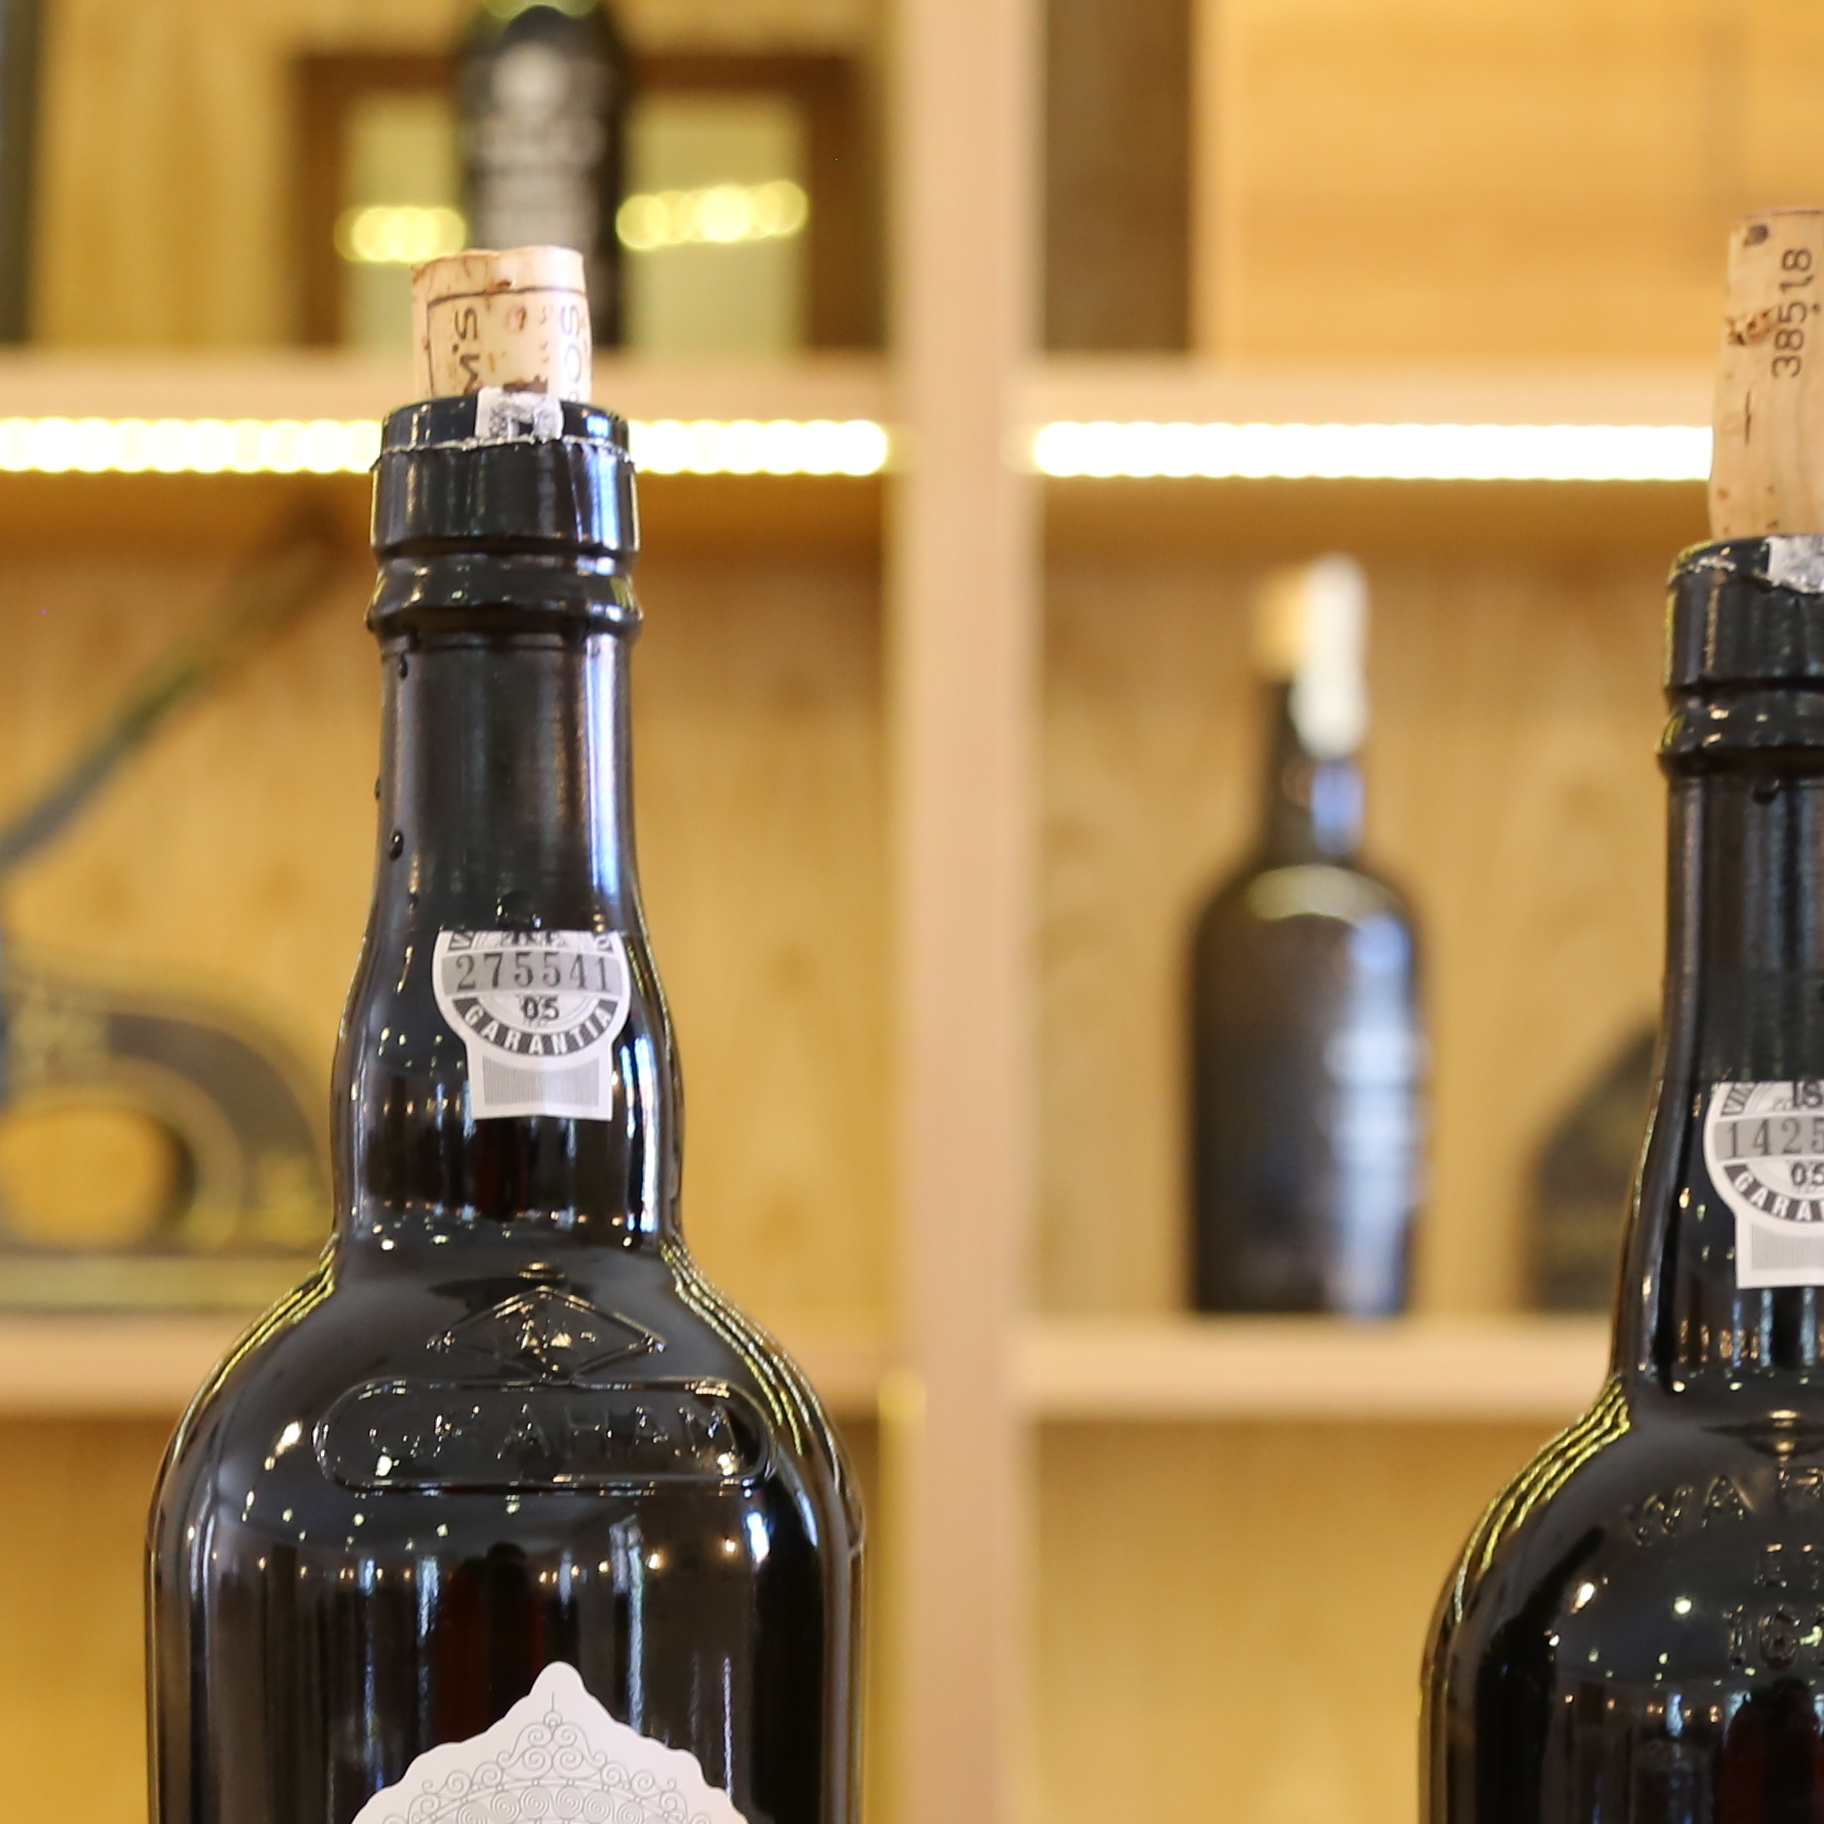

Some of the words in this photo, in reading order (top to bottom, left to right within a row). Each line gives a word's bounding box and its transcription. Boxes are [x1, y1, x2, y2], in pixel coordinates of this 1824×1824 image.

[1771, 248, 1814, 379] 38518
[455, 951, 609, 993] 275541
[464, 1005, 613, 1056] GARANTIA
[521, 995, 561, 1021] 05
